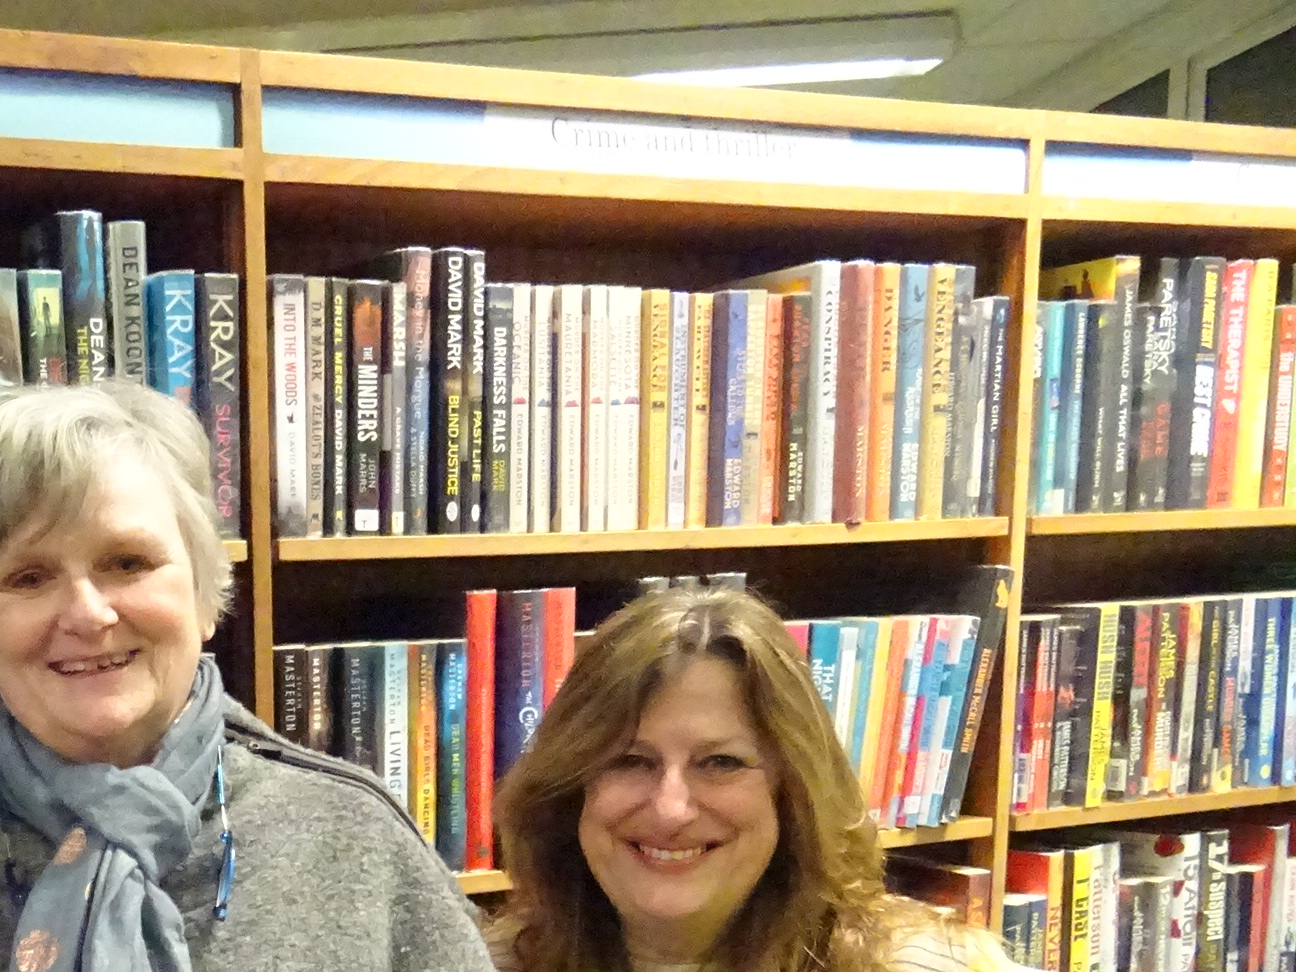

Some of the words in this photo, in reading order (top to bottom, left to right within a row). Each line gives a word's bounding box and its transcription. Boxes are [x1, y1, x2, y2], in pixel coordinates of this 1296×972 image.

[120, 246, 140, 306] DEAN
[447, 256, 464, 313] DAVID
[472, 262, 485, 320] DAVID
[1230, 269, 1247, 303] THE
[283, 303, 297, 333] INTO
[332, 294, 343, 345] CRUEL
[392, 293, 406, 367] MARSH
[1123, 289, 1134, 326] JAMES
[1157, 278, 1174, 375] PARETSKY
[89, 317, 105, 382] DEAN
[164, 289, 194, 379] KRAY
[209, 293, 236, 393] KRAY
[284, 336, 297, 361] THE
[361, 346, 374, 361] THE
[446, 315, 464, 371] MARK
[472, 323, 485, 375] MARK
[931, 276, 948, 395] VENGEANCE
[1120, 329, 1131, 379] OSWALD
[1224, 305, 1246, 394] THERAPIST
[284, 362, 298, 407] WOODS
[332, 352, 343, 403] MERCY
[492, 326, 507, 405] DARKNESS
[992, 345, 1003, 402] MARTIAN
[357, 364, 378, 443] MINDERS
[447, 394, 461, 438] BLIND
[989, 404, 1001, 434] GIRL
[1119, 383, 1129, 405] ALL
[332, 409, 343, 454] DAVID
[472, 409, 483, 446] PAST
[492, 409, 506, 453] FALLS
[1117, 407, 1128, 439] THAT
[215, 403, 237, 519] SURVIVOR
[332, 457, 343, 495] MARK
[358, 453, 367, 494] MARRS
[365, 459, 377, 489] JOHN
[445, 438, 460, 497] JUSTICE
[471, 449, 482, 483] LIFE
[787, 442, 799, 502] MARSTON
[899, 442, 912, 503] MARSTON
[908, 443, 920, 501] EDWARD
[1115, 441, 1125, 472] LIVES
[724, 458, 735, 510] MARSTON
[733, 458, 742, 508] EDWARD
[284, 654, 297, 732] MASTERTON
[312, 657, 322, 730] MASTERTON
[350, 658, 362, 735] MASTERTON
[821, 664, 836, 702] THAT
[389, 730, 402, 790] LIVING
[450, 753, 460, 775] MEN
[1205, 881, 1227, 941] Suspect
